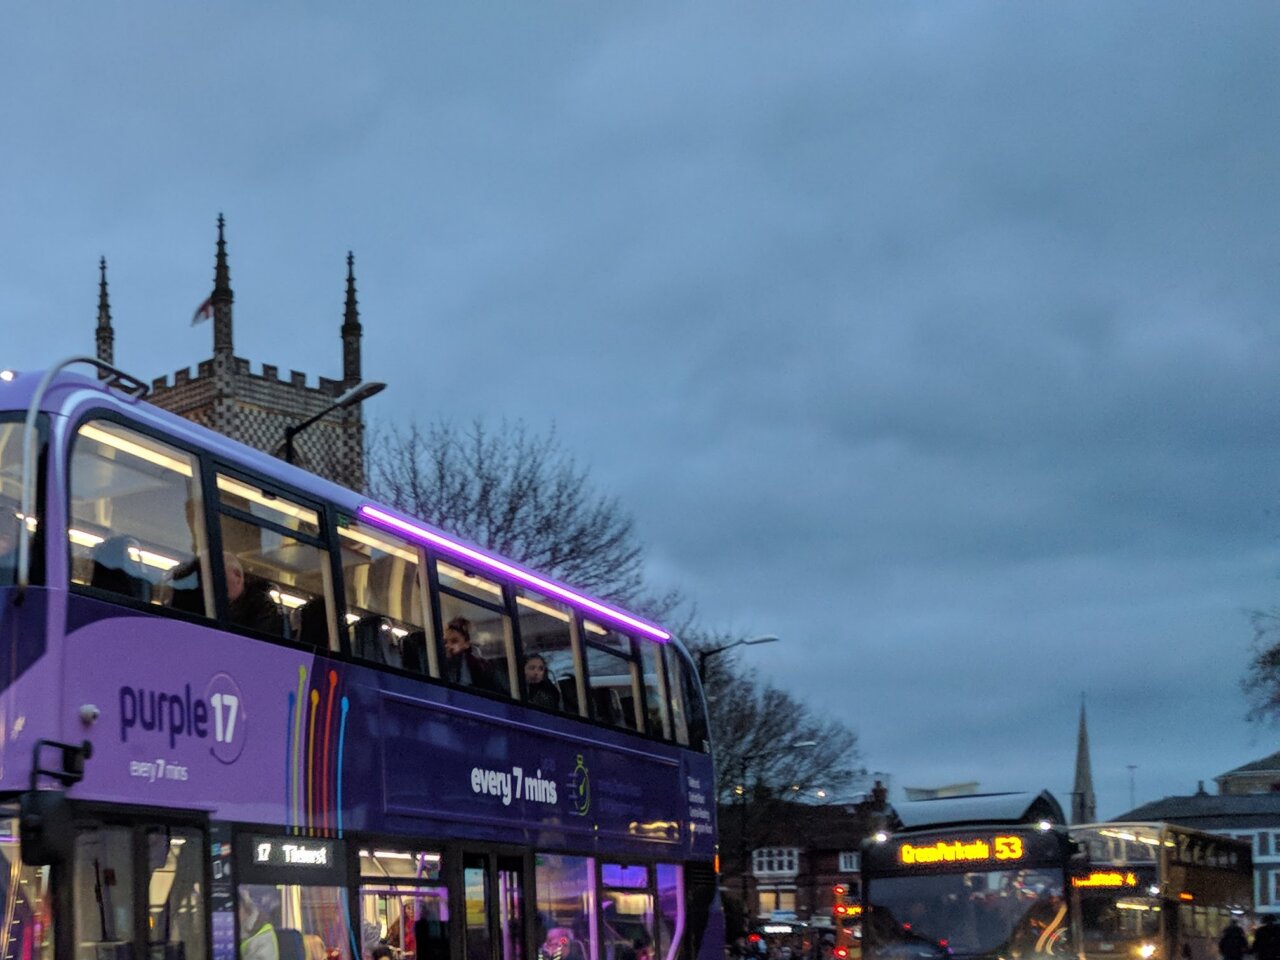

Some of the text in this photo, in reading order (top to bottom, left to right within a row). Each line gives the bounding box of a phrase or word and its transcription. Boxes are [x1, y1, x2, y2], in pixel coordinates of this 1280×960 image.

[119, 682, 239, 749] purple 17
[156, 758, 166, 779] 7
[470, 766, 512, 806] every
[512, 766, 523, 799] 7
[524, 769, 558, 805] mins
[257, 843, 272, 862] 17
[995, 835, 1022, 860] 53
